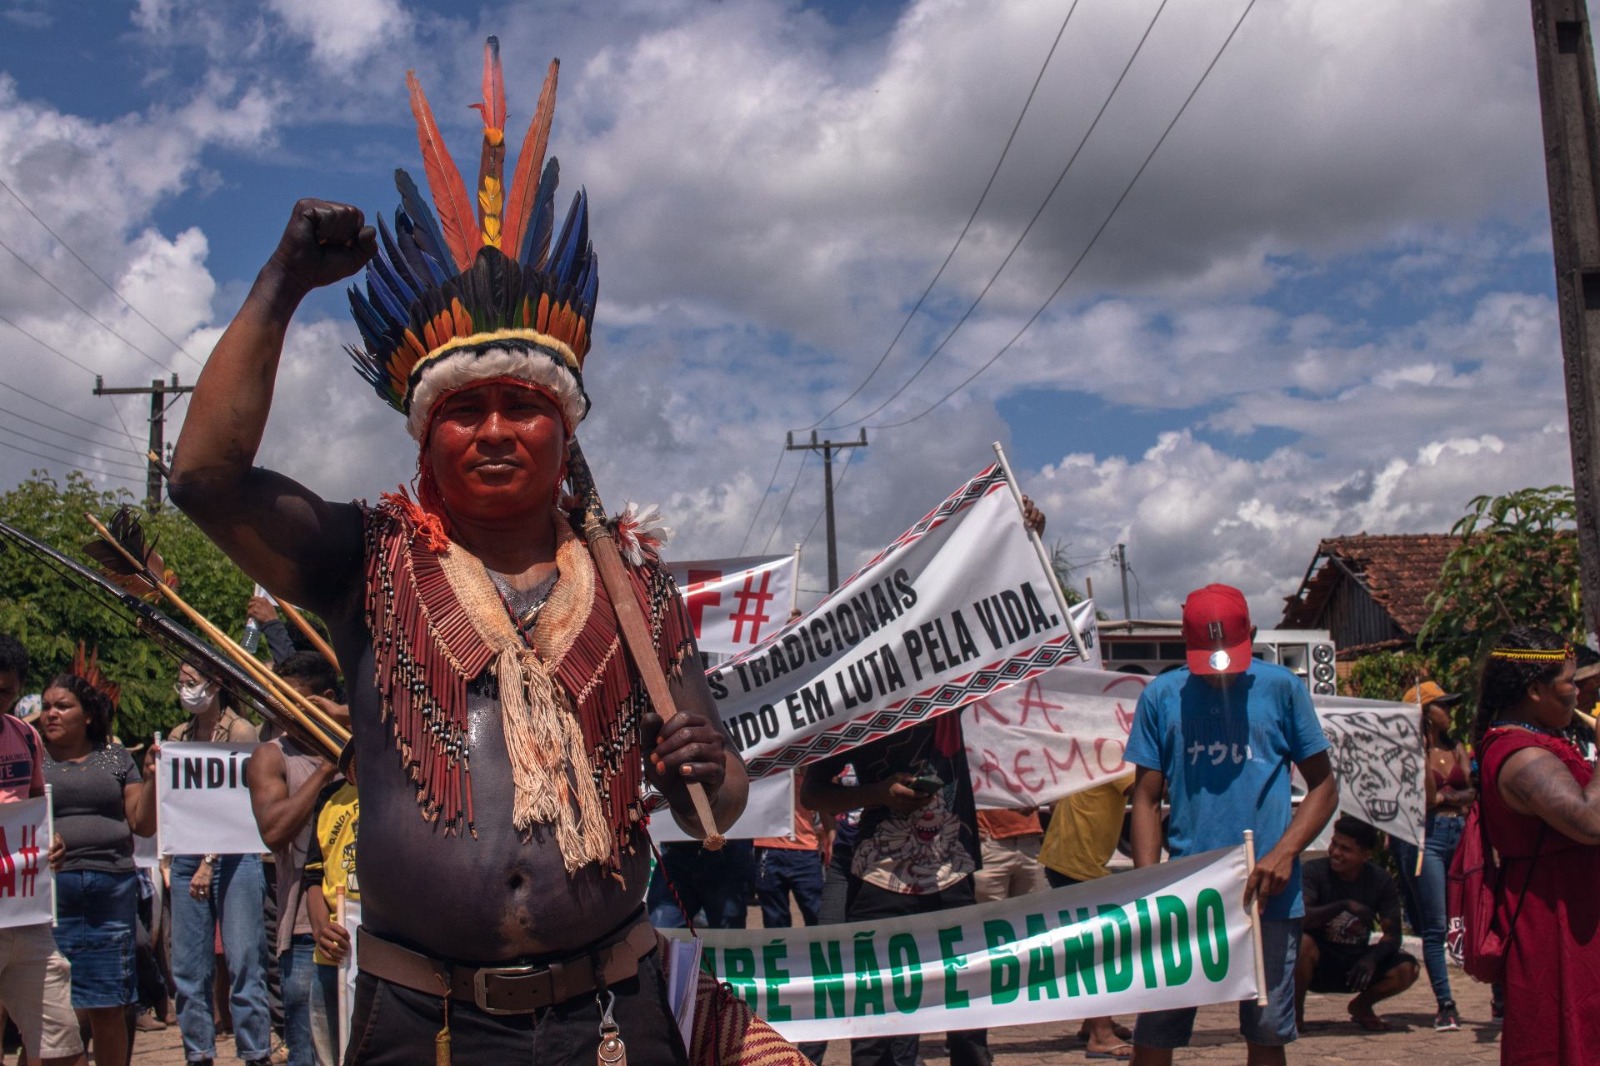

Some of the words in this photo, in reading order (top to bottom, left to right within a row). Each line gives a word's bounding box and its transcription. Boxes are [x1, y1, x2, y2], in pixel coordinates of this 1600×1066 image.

[733, 568, 918, 693] TRADICIONAIS
[785, 680, 835, 730] EM
[835, 643, 906, 710] LUTA
[902, 609, 981, 682] PELA
[973, 581, 1060, 650] VIDA.
[1187, 740, 1253, 766] ナウい
[809, 930, 924, 1020] NÃO
[938, 925, 971, 1009] E
[984, 887, 1230, 1005] BANDIDO
